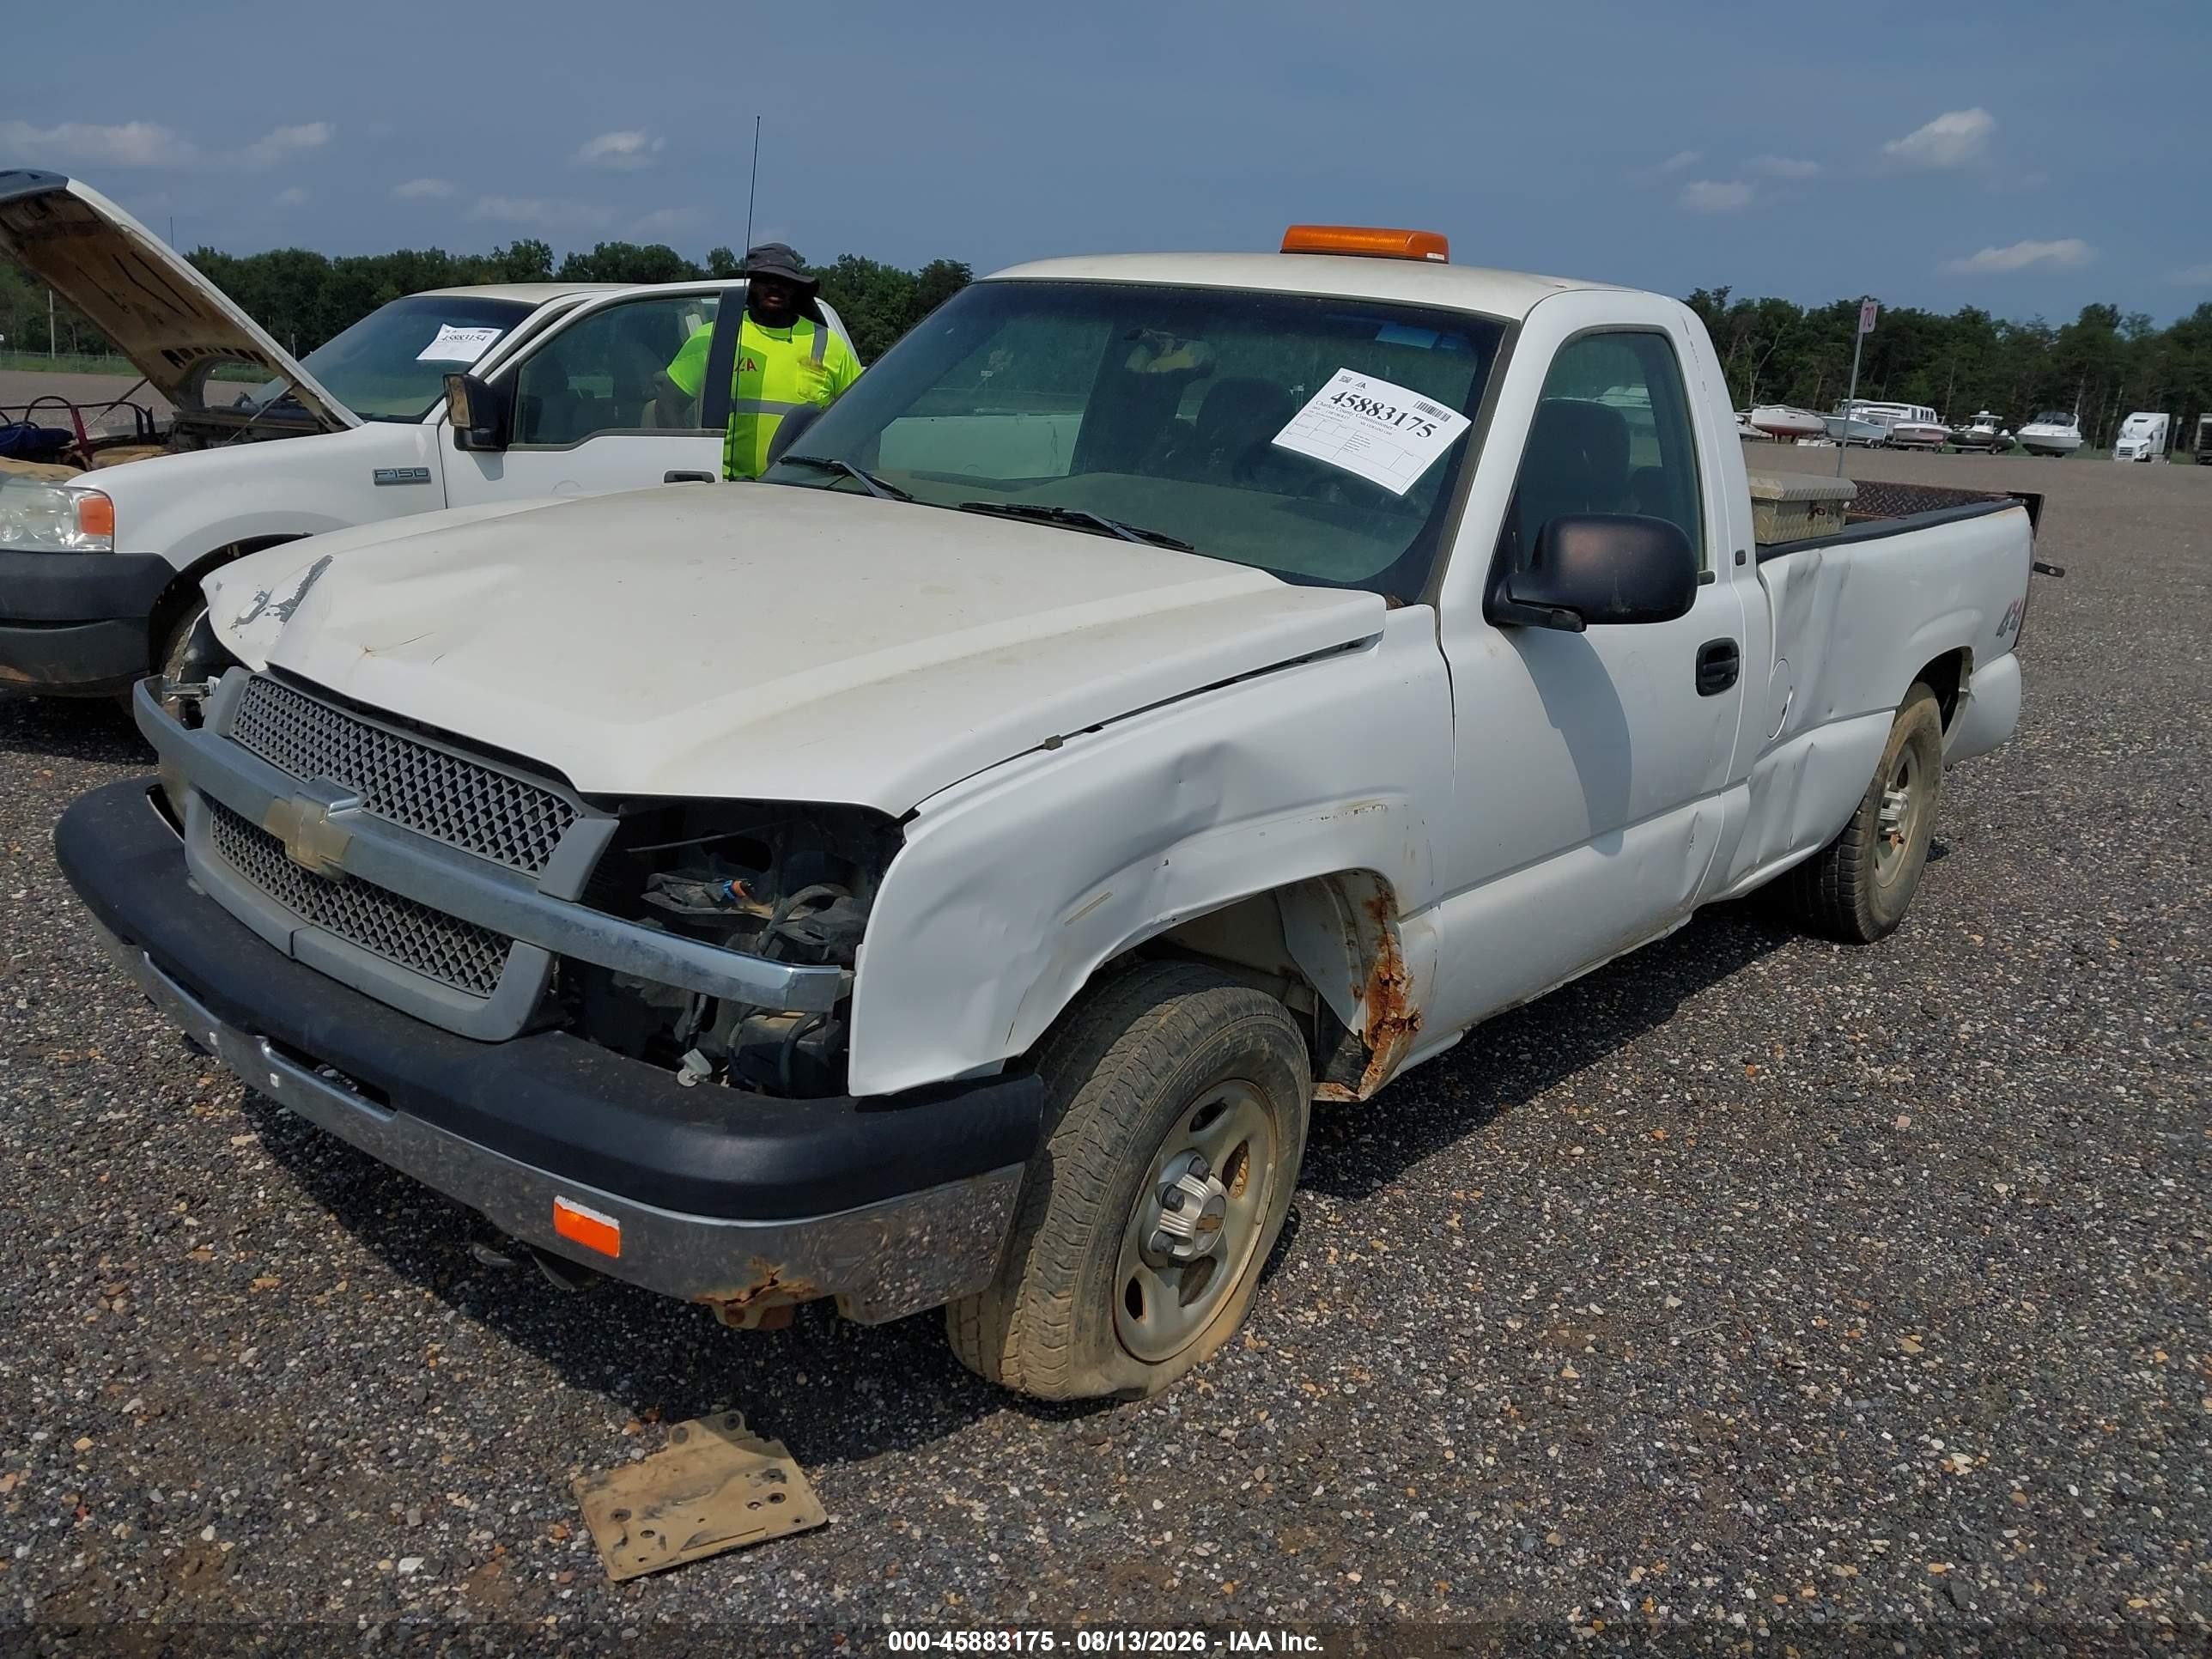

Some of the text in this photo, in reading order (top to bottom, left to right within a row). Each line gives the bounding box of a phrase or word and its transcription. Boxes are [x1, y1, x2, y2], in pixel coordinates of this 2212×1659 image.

[1316, 399, 1336, 410] Charles
[1335, 406, 1355, 416] County
[1330, 391, 1438, 438] 45883175
